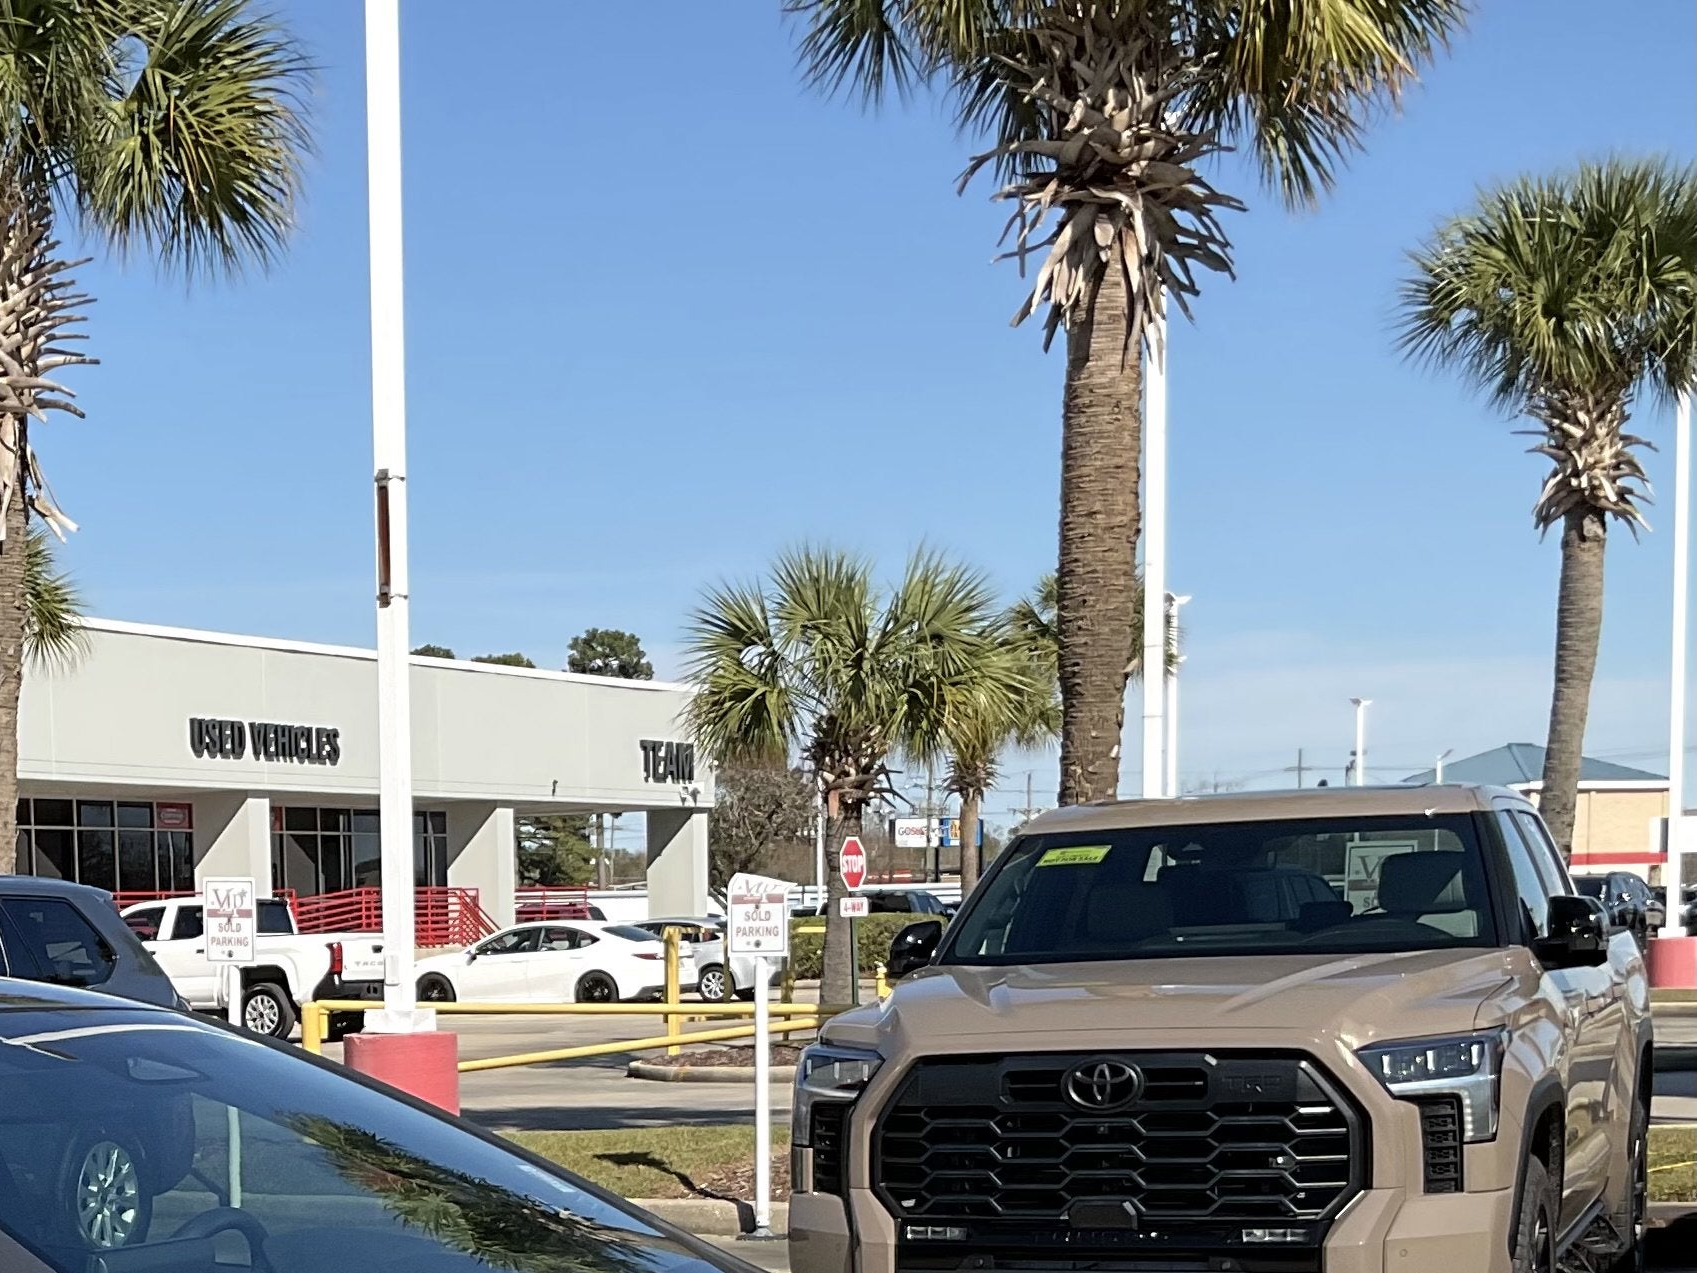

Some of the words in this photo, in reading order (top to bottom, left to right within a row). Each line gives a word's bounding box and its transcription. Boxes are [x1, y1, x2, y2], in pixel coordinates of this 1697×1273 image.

[189, 718, 246, 760] USED
[248, 722, 340, 766] VEHICLES
[639, 740, 694, 784] TEAM
[842, 855, 863, 873] STOP
[744, 911, 771, 922] SOLD
[218, 923, 242, 933] SOLD
[735, 926, 780, 937] PARKING
[210, 936, 249, 947] PARKING
